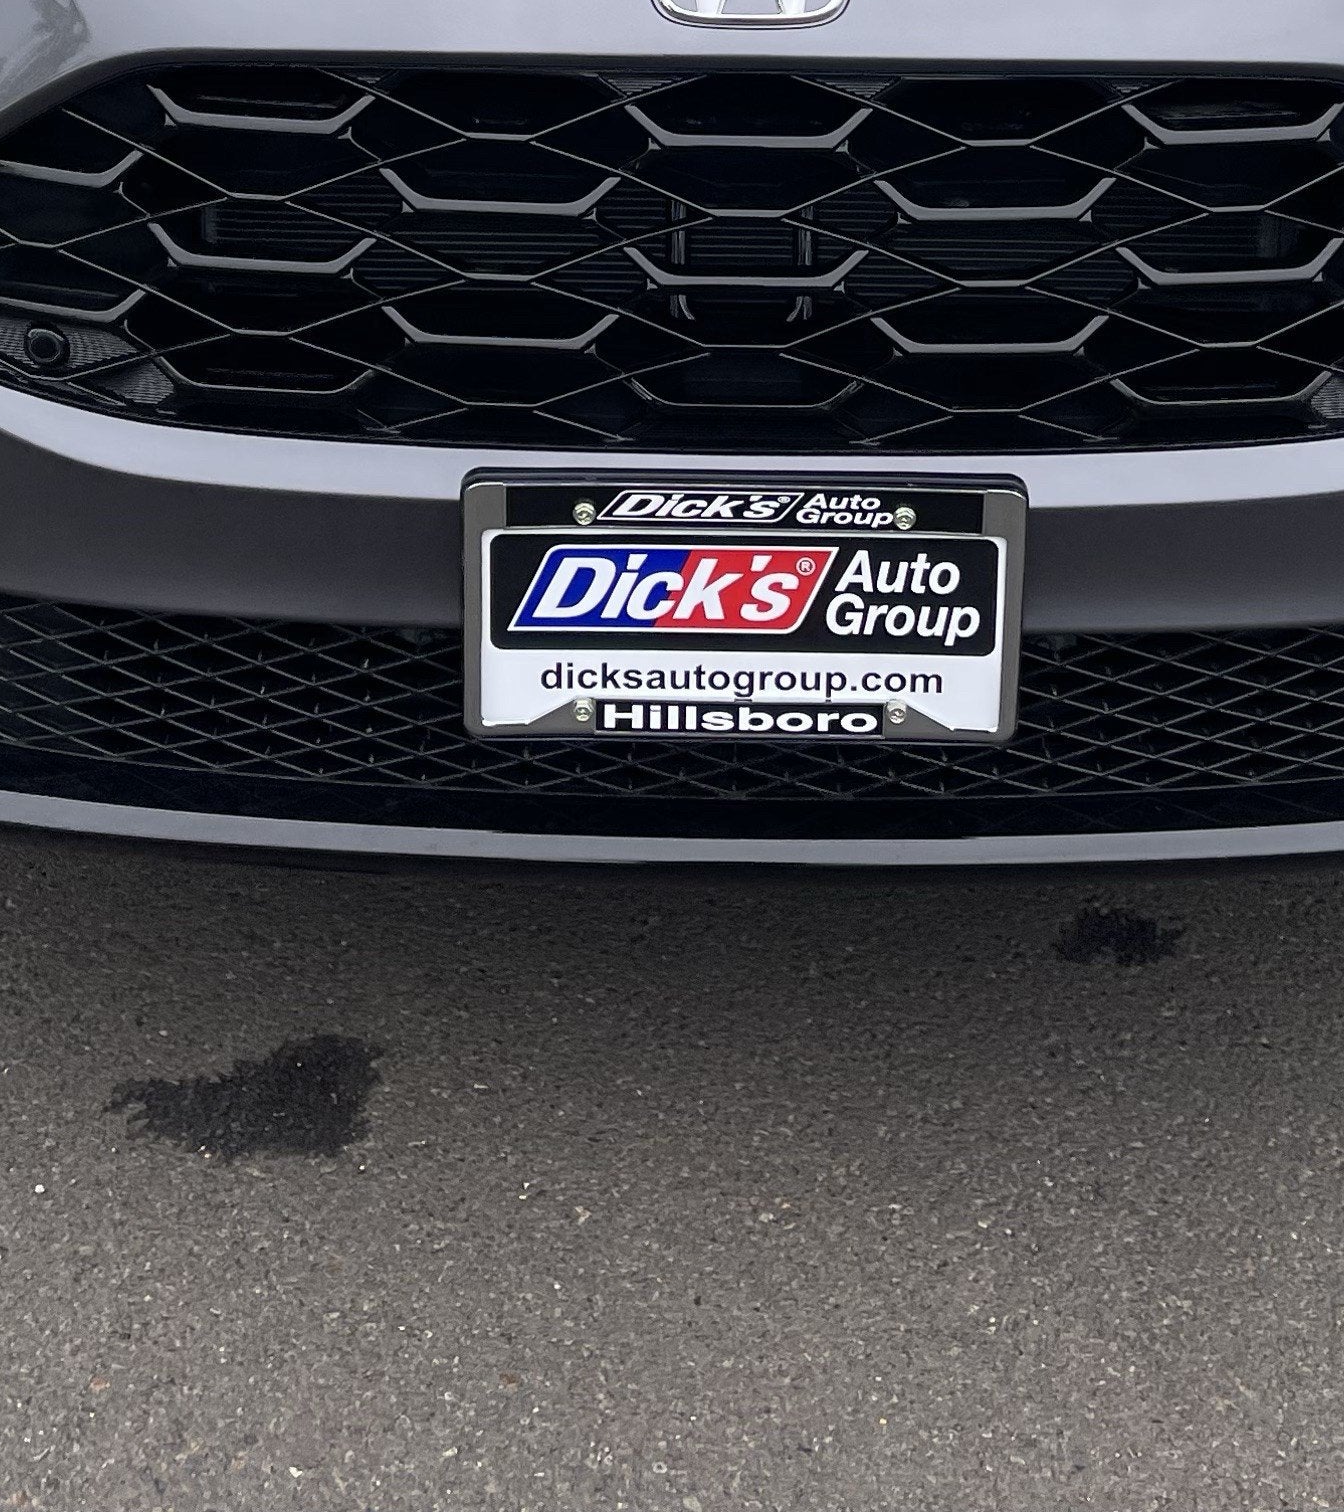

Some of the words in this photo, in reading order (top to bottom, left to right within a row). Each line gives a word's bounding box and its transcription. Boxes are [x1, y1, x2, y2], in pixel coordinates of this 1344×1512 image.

[612, 493, 780, 519] Dick's
[795, 509, 894, 528] Group
[803, 493, 881, 510] Auto
[532, 553, 799, 622] Dick's
[835, 549, 960, 595] Auto
[825, 593, 981, 646] Group
[540, 662, 944, 702] dicksautogroup.com
[603, 703, 878, 733] Hillsboro
